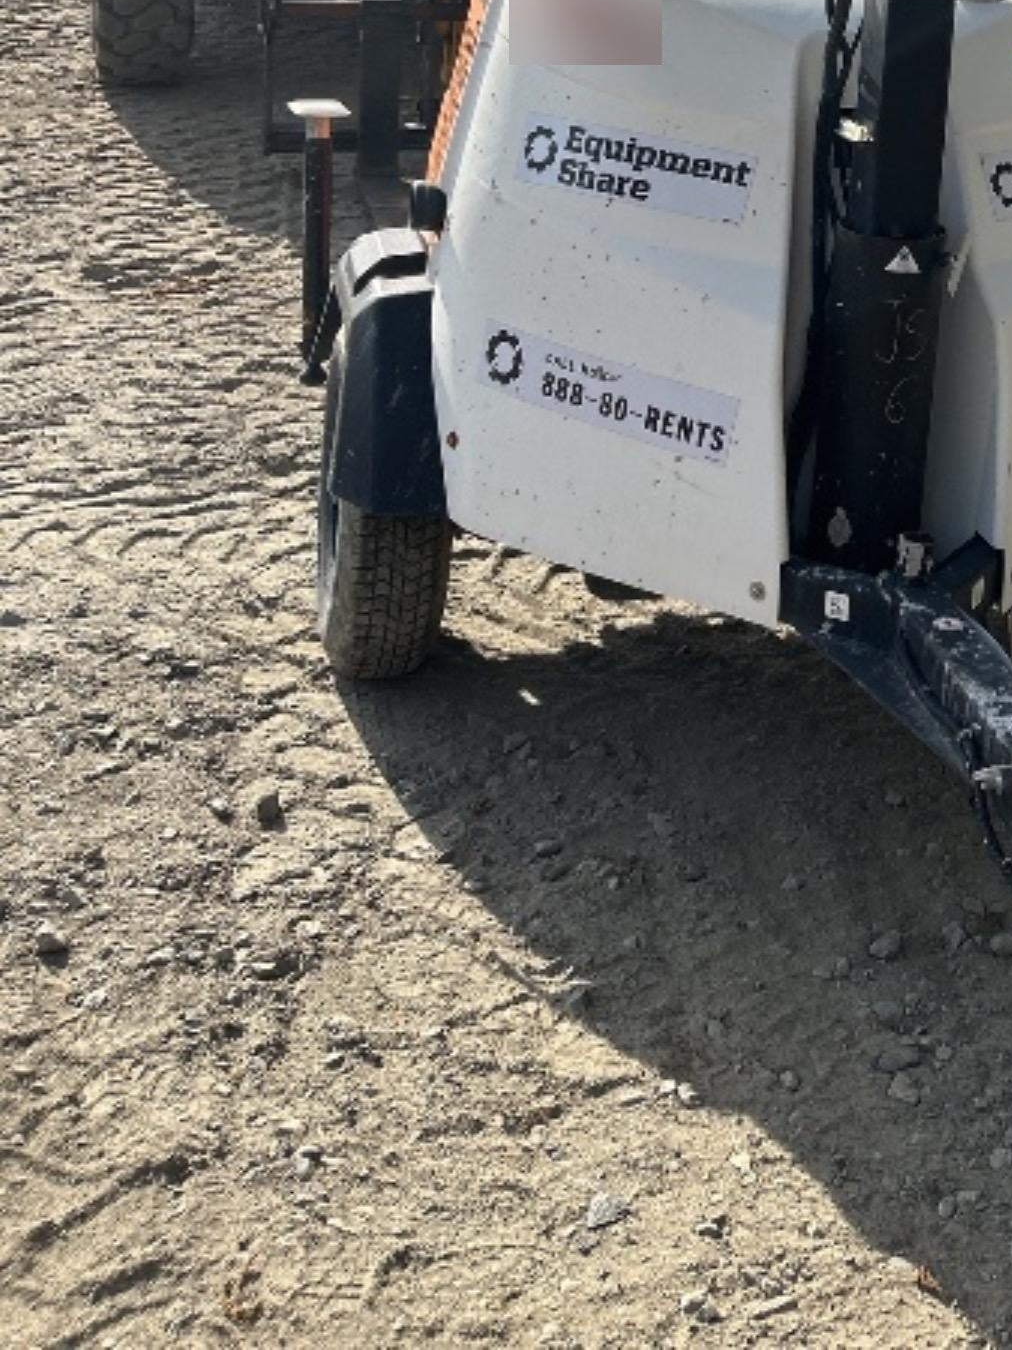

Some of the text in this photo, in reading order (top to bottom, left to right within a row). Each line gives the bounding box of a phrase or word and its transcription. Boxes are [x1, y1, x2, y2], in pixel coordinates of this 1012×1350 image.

[557, 158, 652, 202] Share
[563, 125, 752, 188] Equipment
[541, 371, 726, 453] 888-80-RENTS
